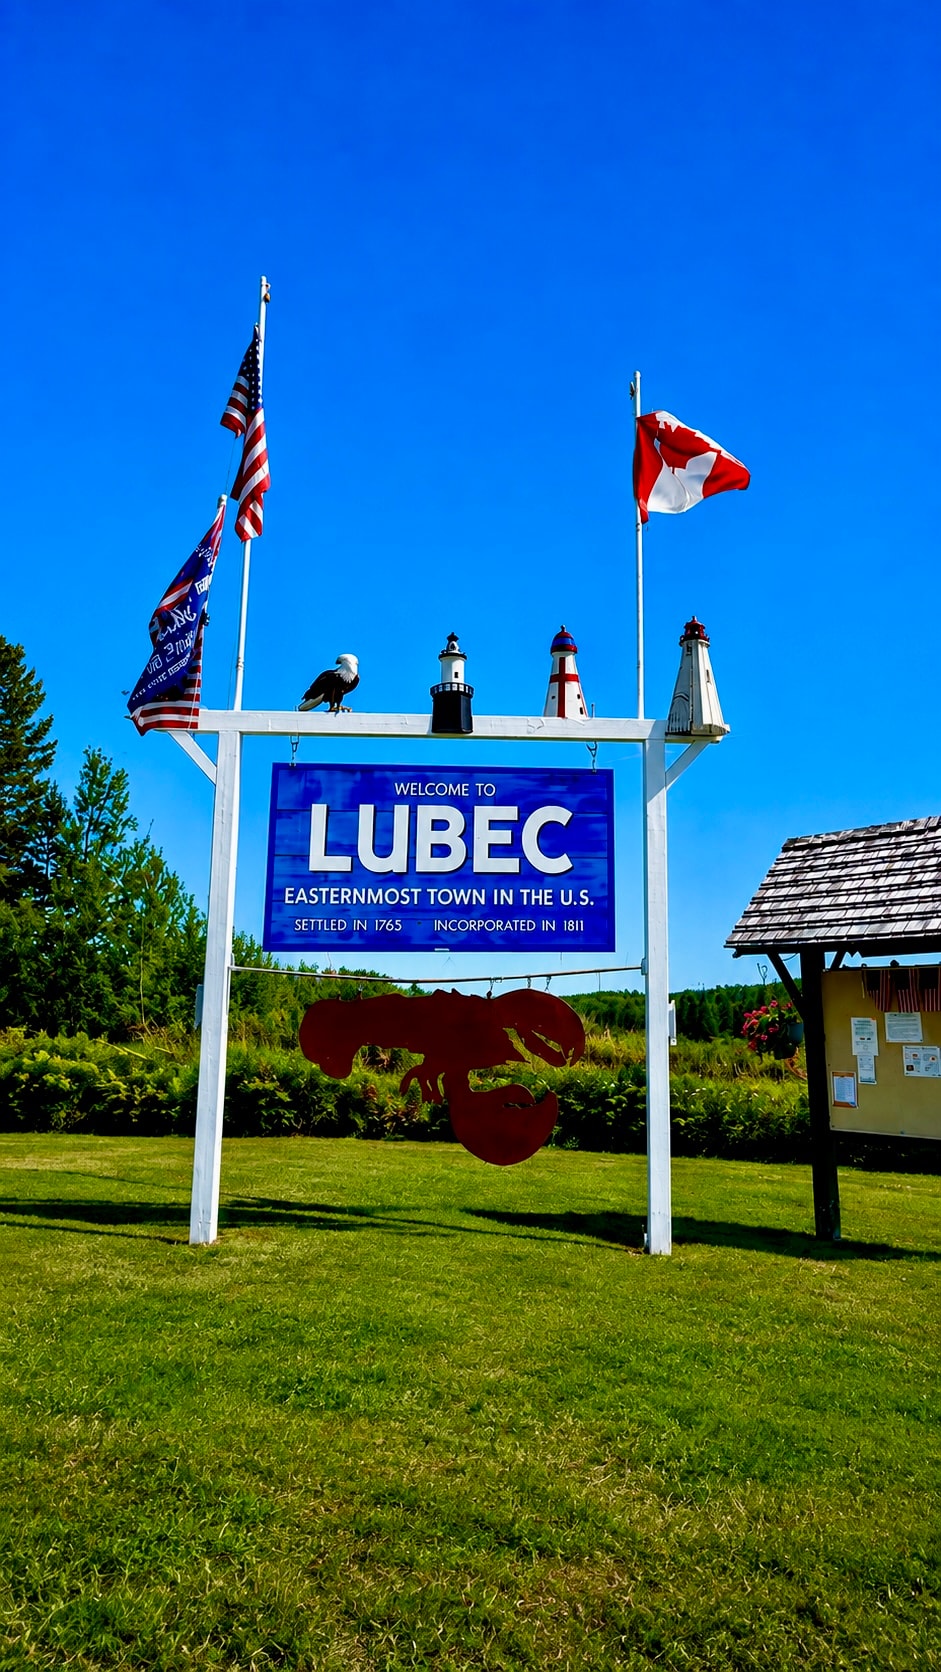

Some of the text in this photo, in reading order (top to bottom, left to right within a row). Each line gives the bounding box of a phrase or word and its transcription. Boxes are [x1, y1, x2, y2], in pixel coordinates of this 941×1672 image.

[395, 782, 497, 797] WELCOME TO
[308, 803, 574, 874] LUBEC
[284, 887, 595, 907] EASTERNMOST TOWN IN THE U.S.
[294, 918, 403, 932] SETTLED IN 1765
[434, 919, 585, 932] INCORPORATED IN 1811
